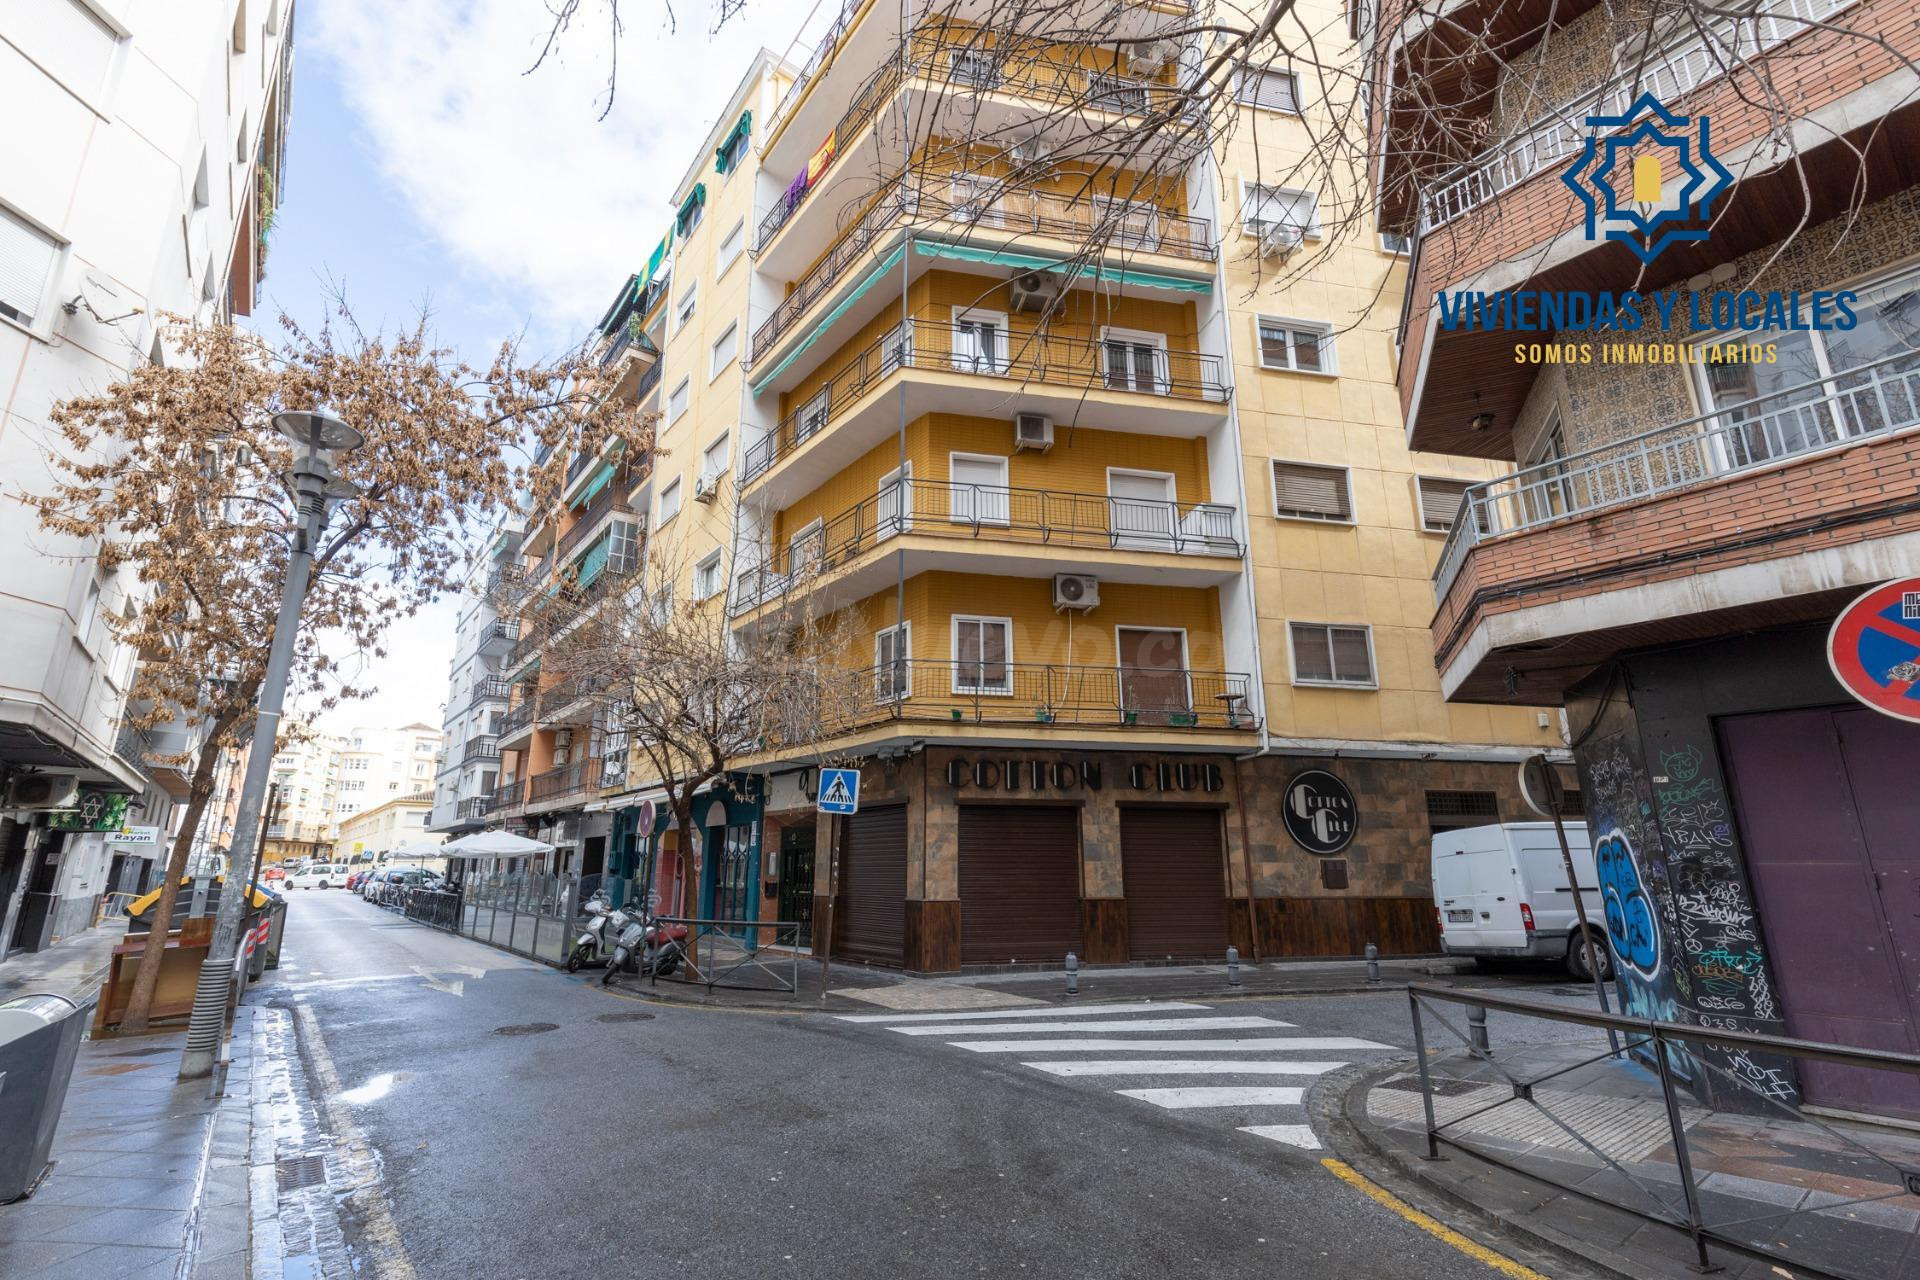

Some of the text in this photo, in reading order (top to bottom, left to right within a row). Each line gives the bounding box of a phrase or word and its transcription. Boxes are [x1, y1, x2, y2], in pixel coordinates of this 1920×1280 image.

[945, 759, 1225, 792] COTTON CLUB
[114, 834, 151, 842] Rayan
